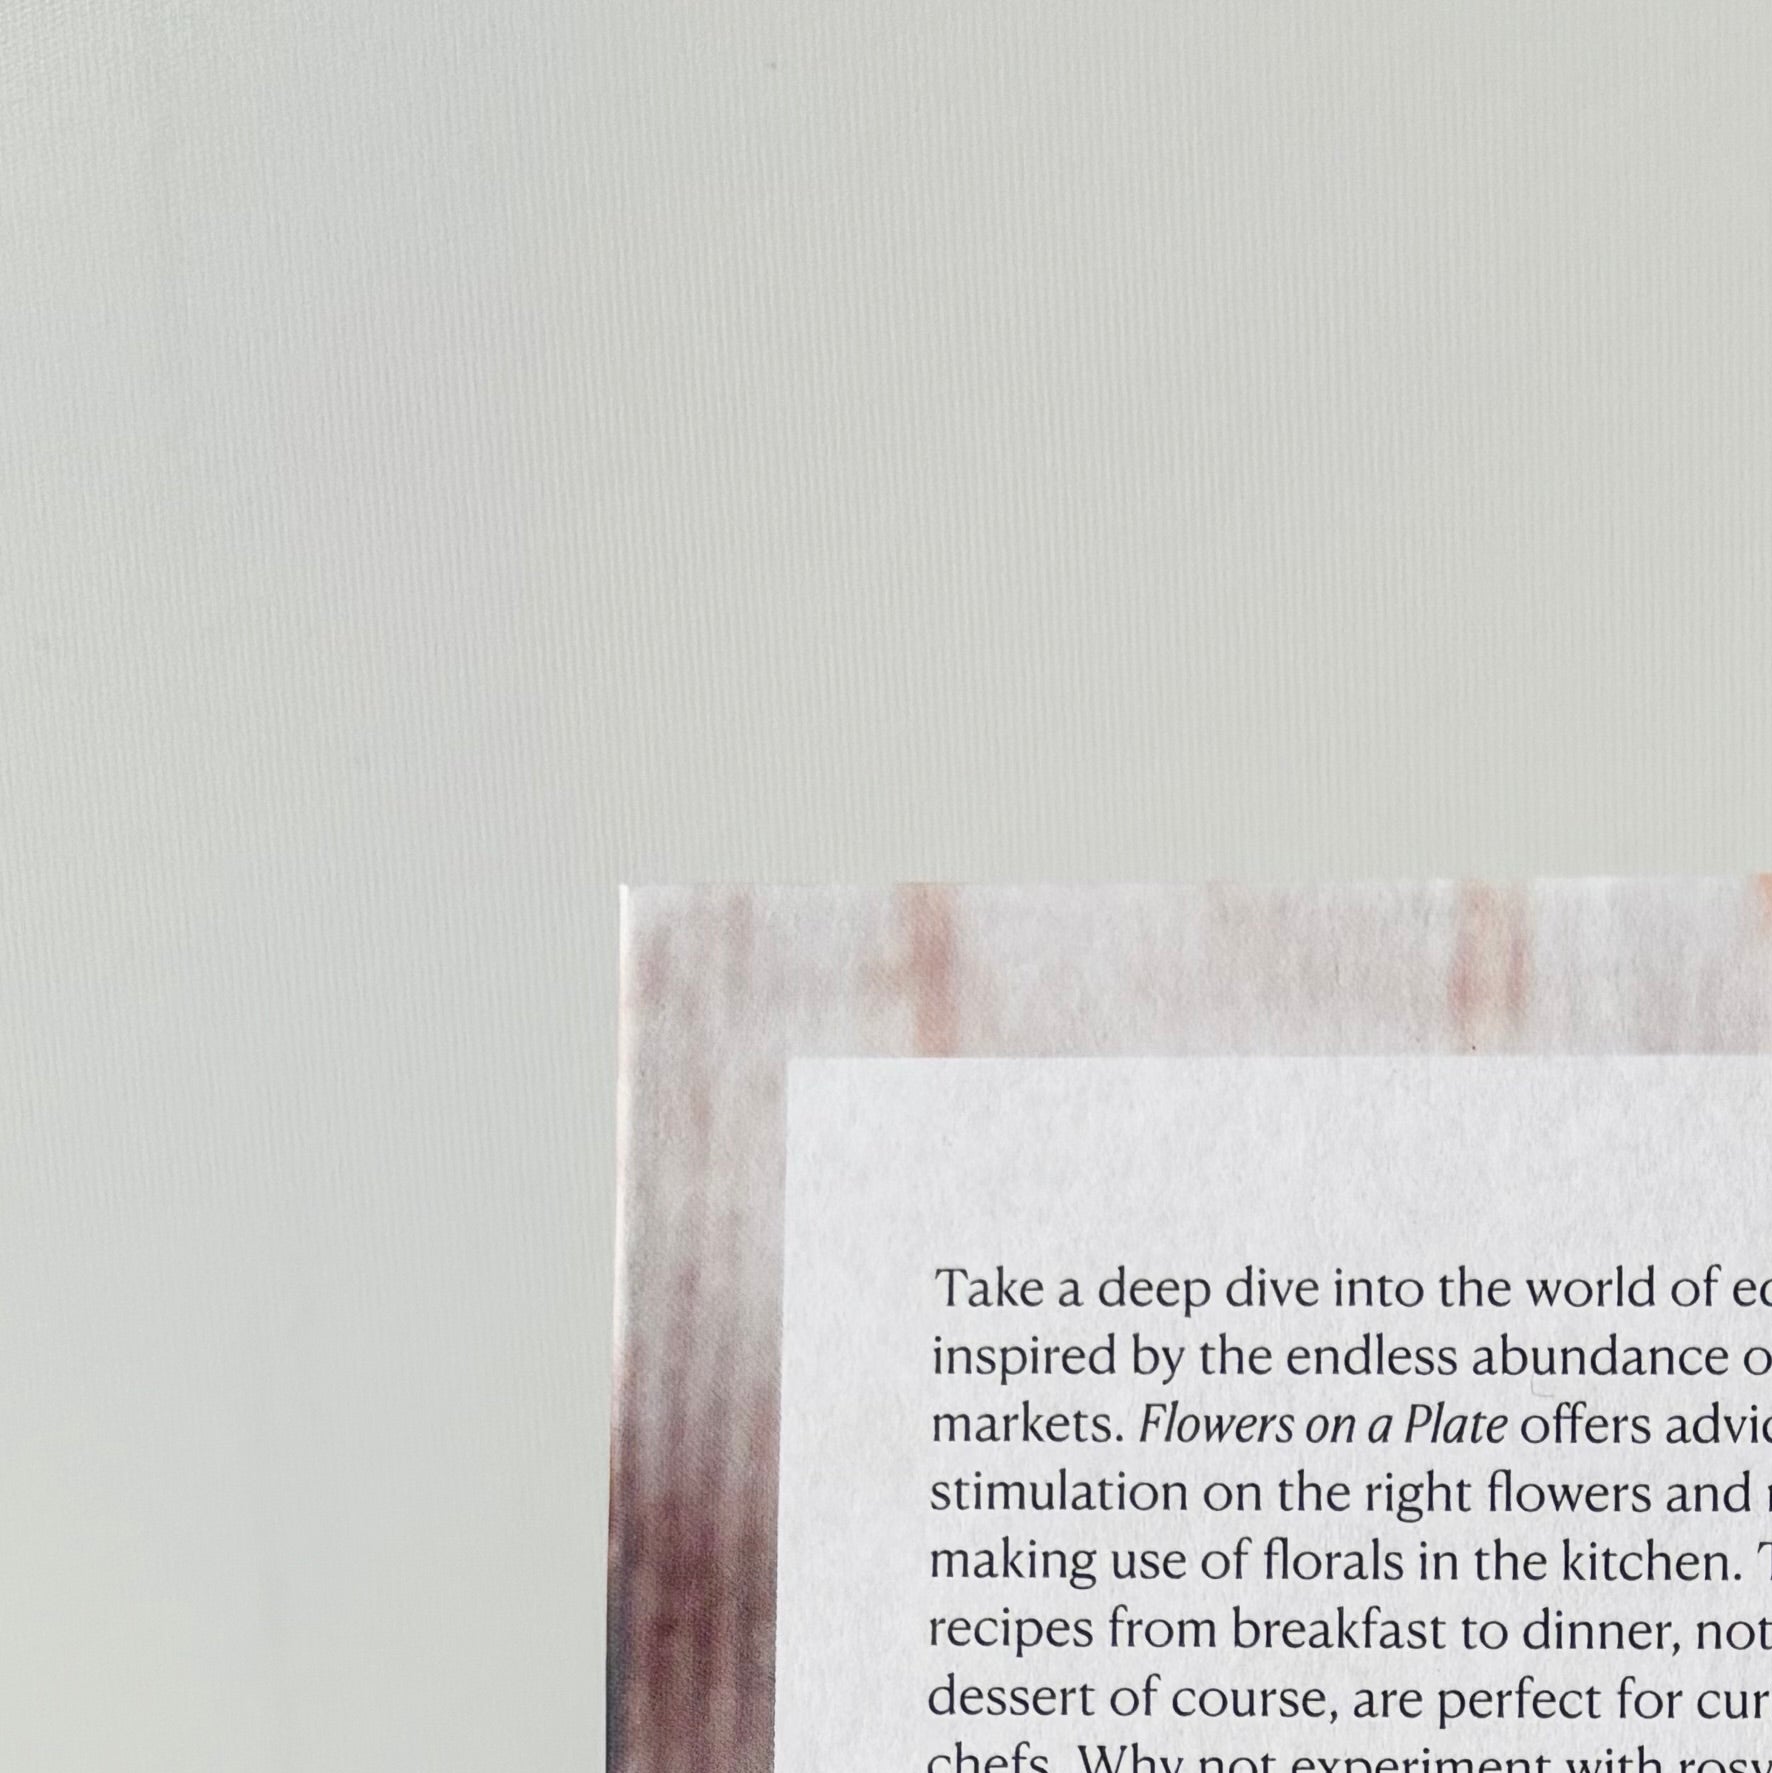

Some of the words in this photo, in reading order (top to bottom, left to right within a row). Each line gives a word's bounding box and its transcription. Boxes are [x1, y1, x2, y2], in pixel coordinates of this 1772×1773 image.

[934, 1264, 1044, 1308] Take
[1058, 1277, 1085, 1308] a
[1098, 1264, 1212, 1319] deep
[1225, 1263, 1320, 1308] dive
[1334, 1267, 1425, 1308] into
[1438, 1264, 1512, 1308] the
[1525, 1263, 1656, 1308] world
[1670, 1263, 1723, 1308] of
[933, 1331, 1116, 1386] inspired
[1131, 1331, 1186, 1386] by
[1199, 1331, 1273, 1376] the
[1286, 1331, 1458, 1376] endless
[1472, 1332, 1729, 1376] abundance
[932, 1399, 1124, 1444] markets.
[1138, 1399, 1295, 1444] Flowers
[1305, 1413, 1357, 1444] on
[1367, 1414, 1394, 1444] a
[1404, 1400, 1509, 1445] Plate
[1520, 1400, 1652, 1445] offers
[930, 1467, 1188, 1512] stimulation
[1203, 1481, 1262, 1512] on
[1277, 1467, 1351, 1512] the
[1365, 1468, 1473, 1524] right
[1487, 1468, 1652, 1514] flowers
[1666, 1469, 1751, 1514] and
[930, 1535, 1098, 1591] making
[1111, 1550, 1187, 1580] use
[1200, 1535, 1253, 1580] of
[1263, 1535, 1404, 1581] florals
[1418, 1540, 1458, 1581] in
[1473, 1537, 1548, 1582] the
[1562, 1537, 1742, 1582] kitchen.
[929, 1606, 1094, 1659] recipes
[1108, 1603, 1217, 1648] from
[1232, 1604, 1447, 1650] breakfast
[1461, 1615, 1509, 1651] to
[1522, 1606, 1681, 1657] dinner,
[927, 1671, 1096, 1717] dessert
[1109, 1672, 1162, 1717] of
[1171, 1687, 1338, 1725] course,
[1353, 1688, 1423, 1719] are
[1437, 1674, 1602, 1730] perfect
[1616, 1675, 1684, 1720] for
